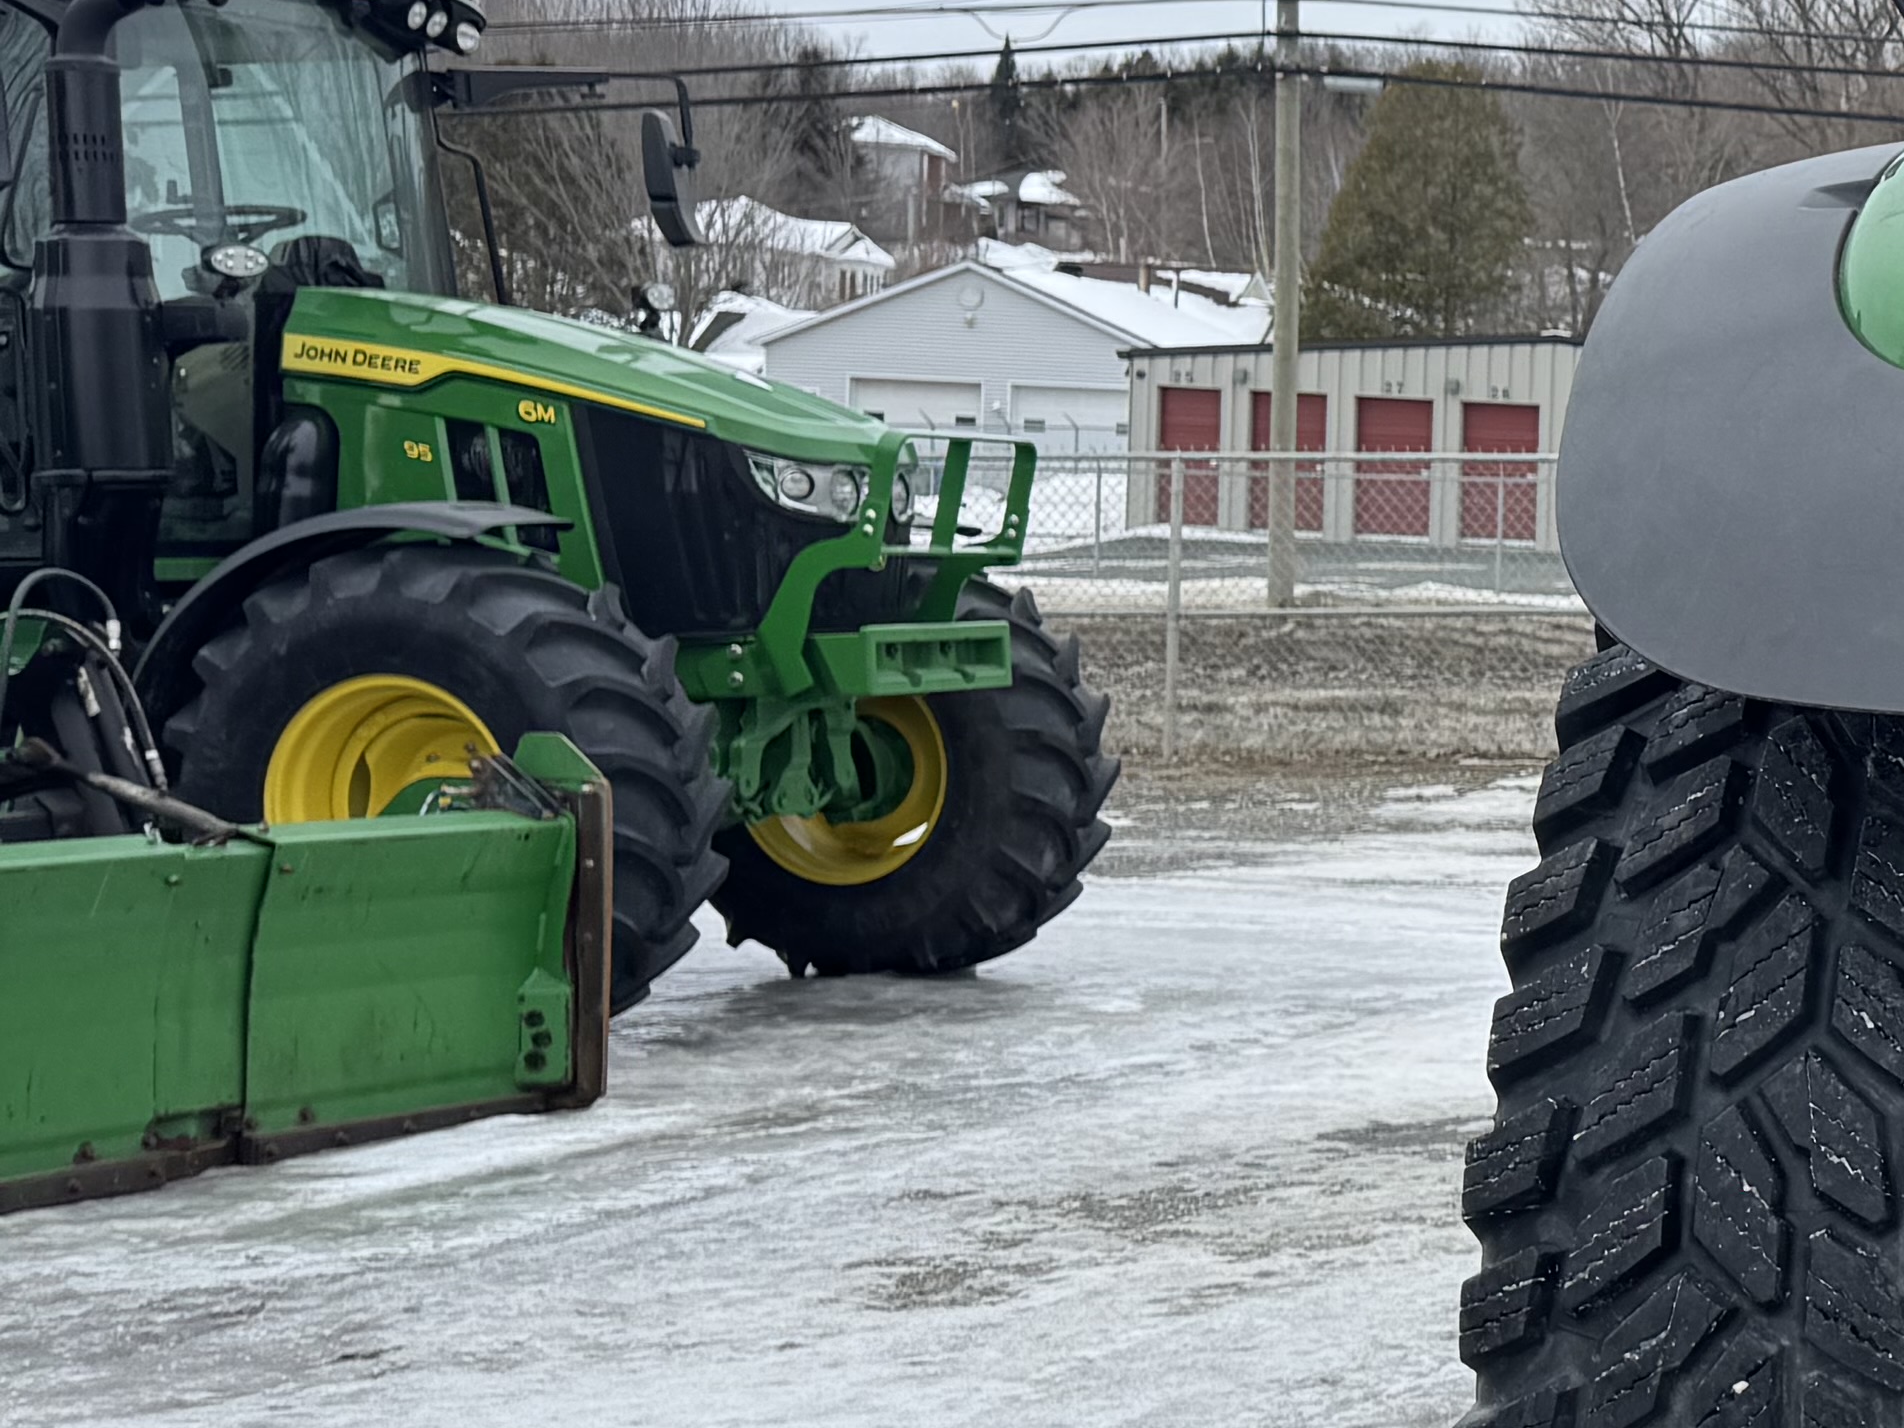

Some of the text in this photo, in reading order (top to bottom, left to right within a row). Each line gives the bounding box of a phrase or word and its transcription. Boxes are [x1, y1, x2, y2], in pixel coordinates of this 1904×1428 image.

[294, 341, 421, 374] JOHN DEERE
[517, 399, 556, 424] 6M
[403, 440, 432, 462] 95
